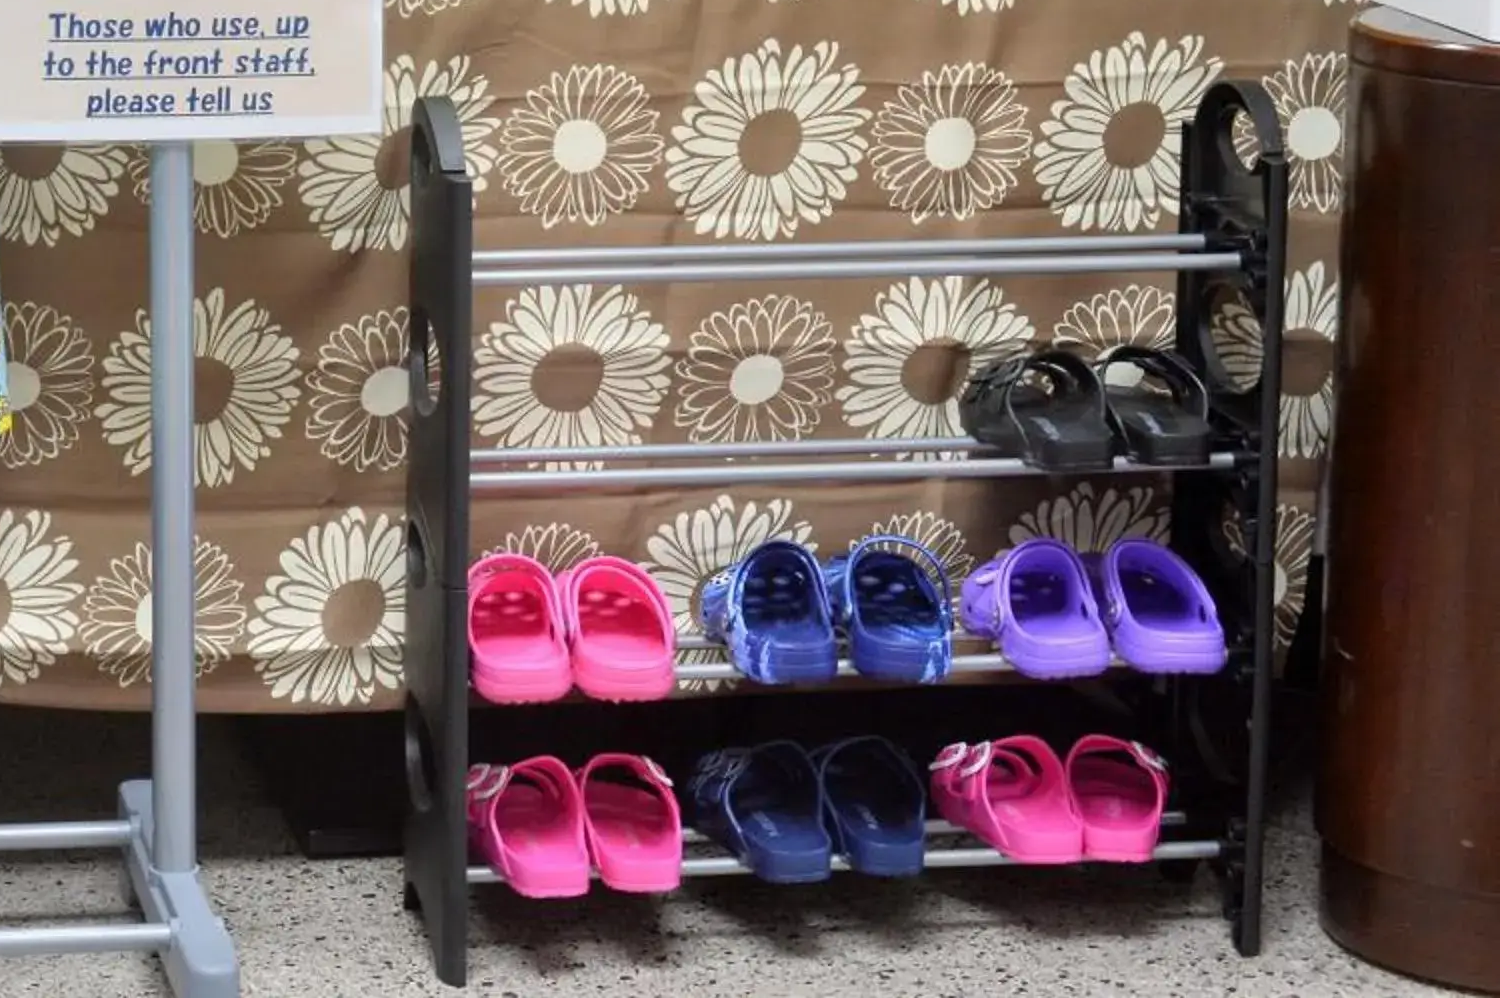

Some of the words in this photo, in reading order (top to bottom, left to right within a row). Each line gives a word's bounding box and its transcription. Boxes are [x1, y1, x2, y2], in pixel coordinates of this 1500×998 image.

[48, 12, 133, 38] Those
[145, 12, 200, 36] who
[276, 14, 310, 38] up
[44, 52, 74, 77] to
[85, 50, 133, 76] the
[144, 49, 223, 75] front
[86, 88, 175, 118] please
[187, 87, 231, 113] tell
[242, 89, 273, 112] us
